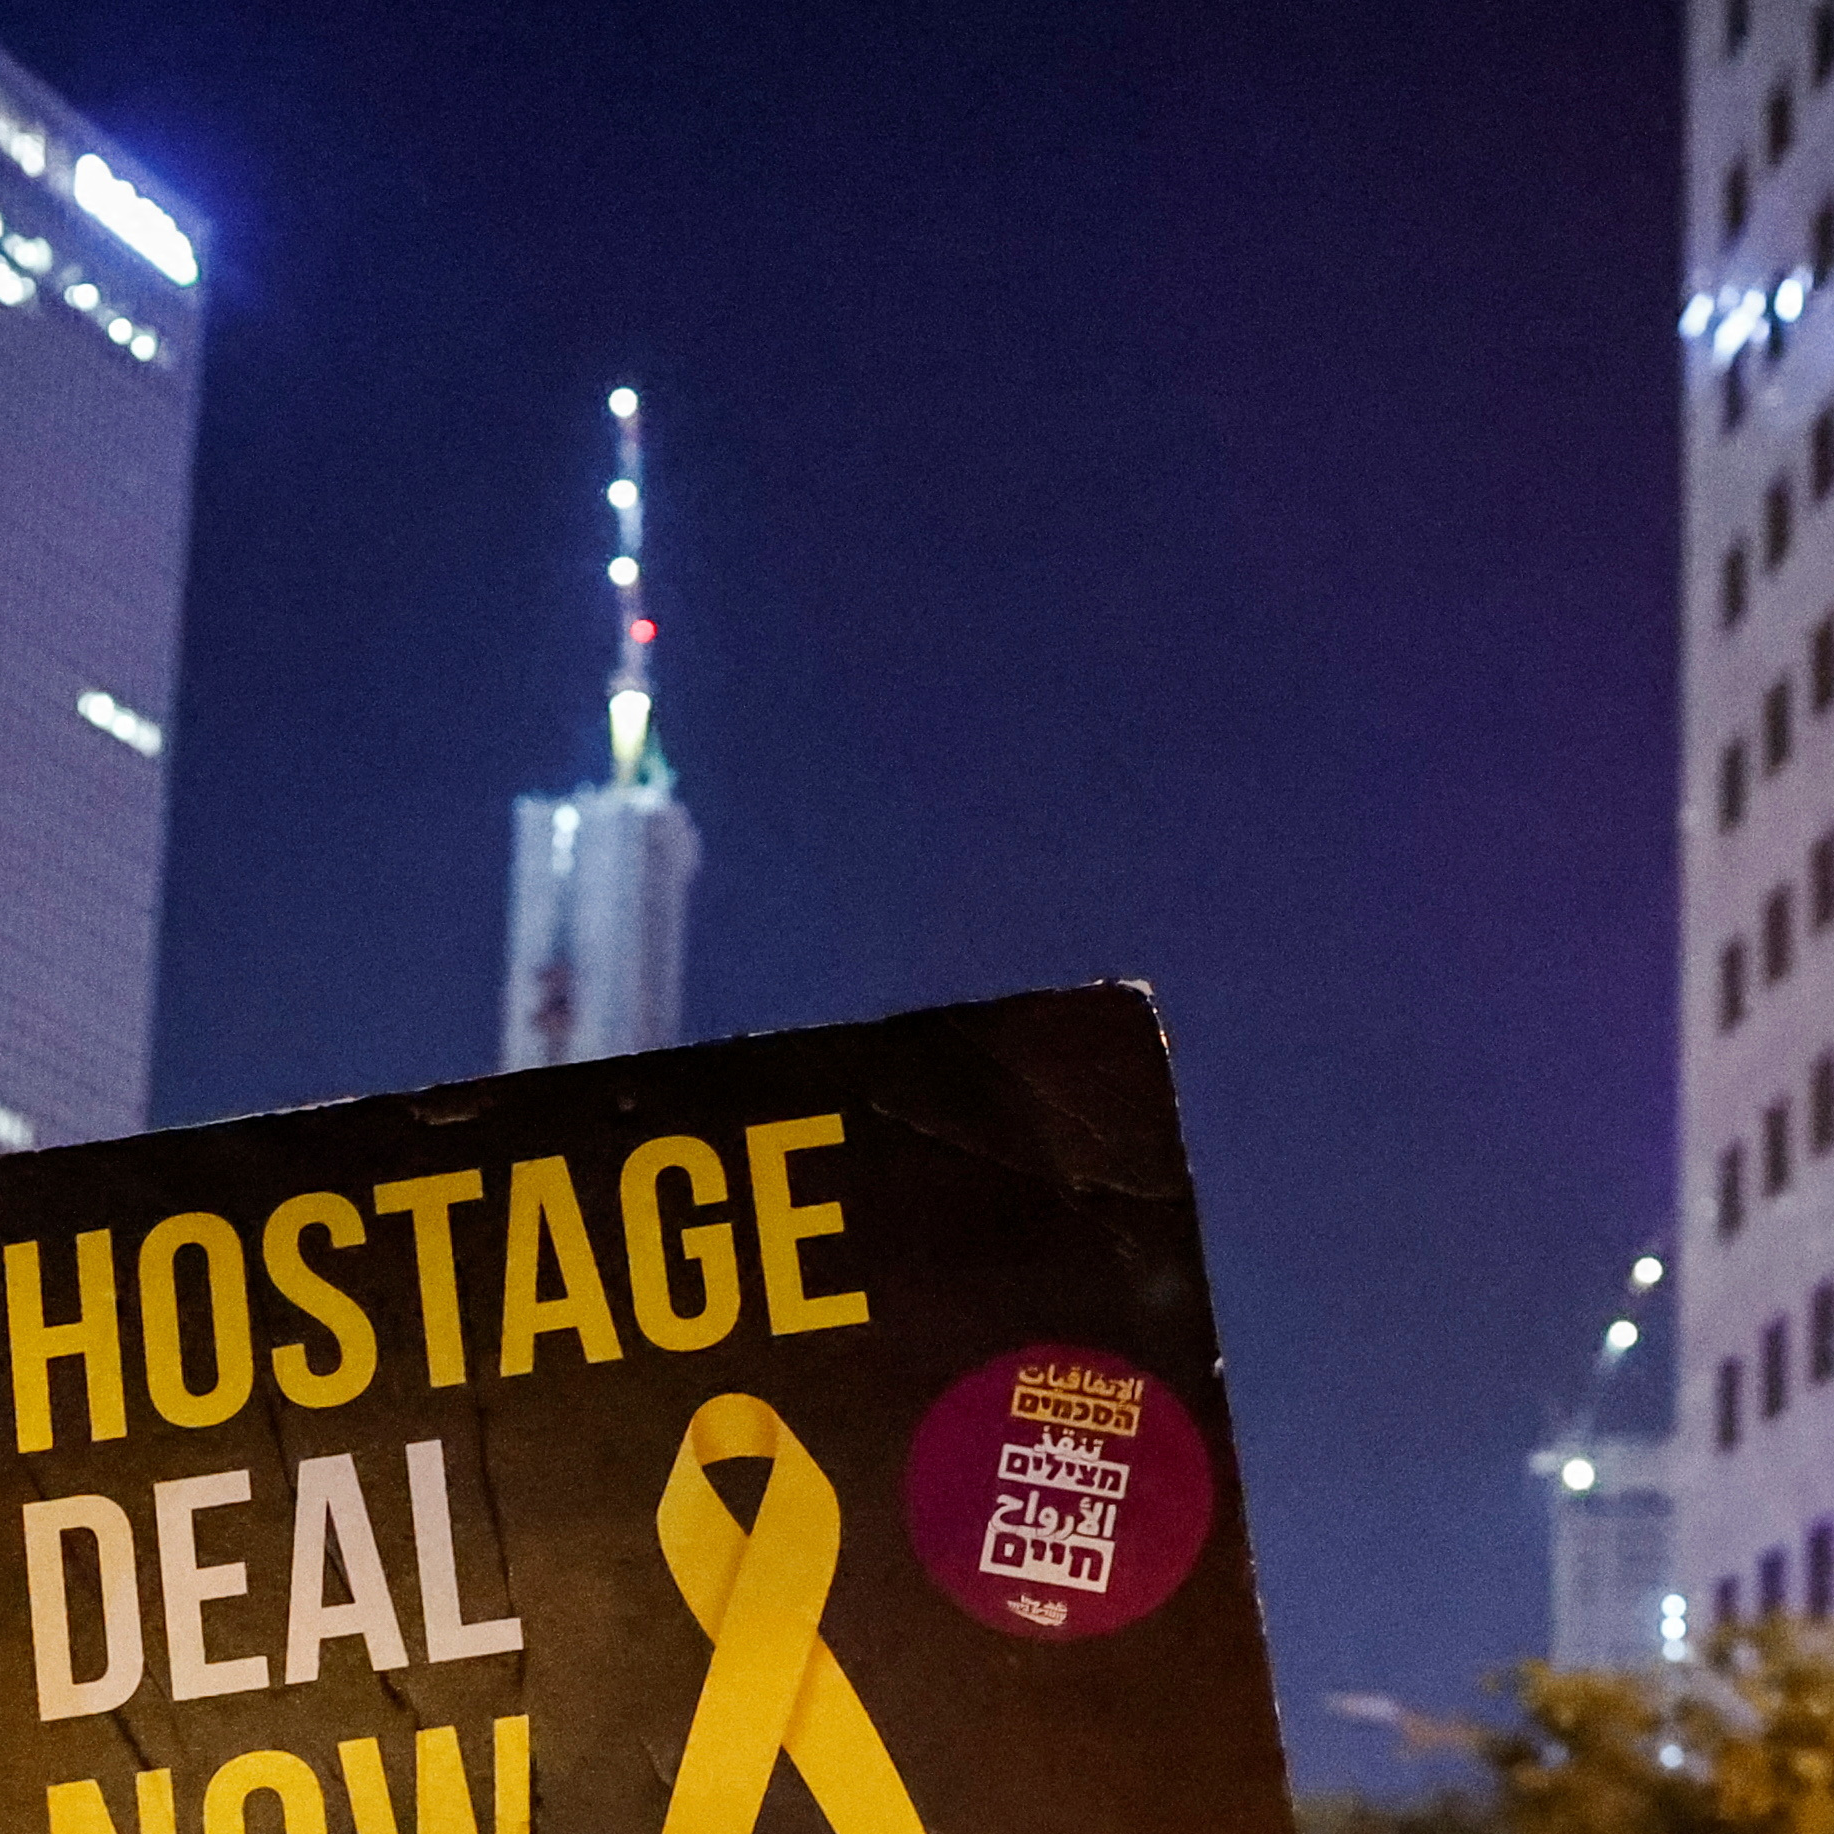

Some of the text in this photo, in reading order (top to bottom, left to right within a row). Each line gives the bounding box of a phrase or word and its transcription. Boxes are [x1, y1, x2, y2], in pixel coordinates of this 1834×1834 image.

[3, 1113, 869, 1453] HOSTAGE
[1017, 1392, 1135, 1431] הסכמים
[1006, 1452, 1123, 1492] מצילים
[987, 1490, 1117, 1539] الأرواح
[23, 1439, 523, 1722] DEAL
[990, 1532, 1104, 1582] חיים
